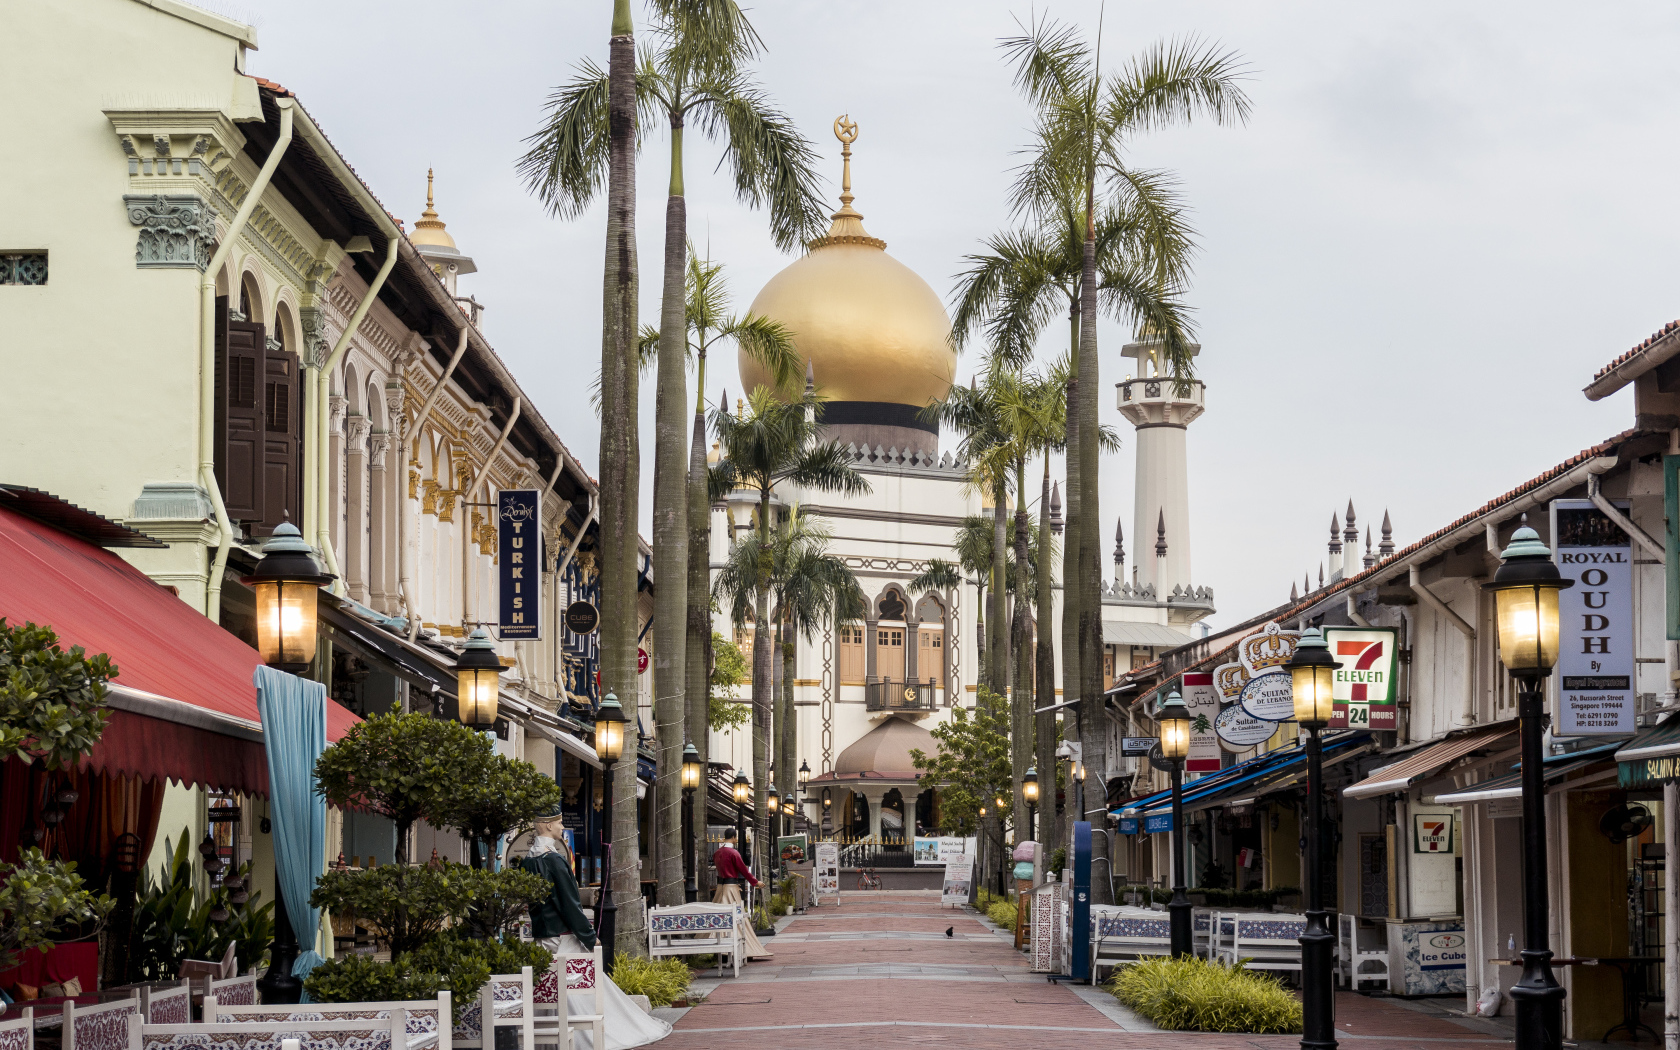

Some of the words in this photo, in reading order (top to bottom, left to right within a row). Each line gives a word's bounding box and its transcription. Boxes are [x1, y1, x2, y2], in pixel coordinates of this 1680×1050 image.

[1561, 552, 1627, 564] ROYAL
[512, 522, 524, 624] TURKISH
[1580, 568, 1611, 654] OUDH
[1337, 641, 1383, 701] 7
[1590, 660, 1602, 673] By
[1565, 677, 1587, 690] Royal
[1587, 677, 1627, 690] Fragrances
[1261, 689, 1289, 698] SULTAN
[1187, 696, 1215, 708] لبنان
[1570, 703, 1600, 711] Singapore
[1235, 718, 1258, 726] Sultan
[1331, 711, 1345, 719] PEN
[1350, 708, 1368, 723] 24
[1371, 711, 1394, 720] HOURS
[1423, 822, 1445, 850] 7
[1421, 953, 1438, 961] Ice
[1441, 951, 1467, 960] Cube
